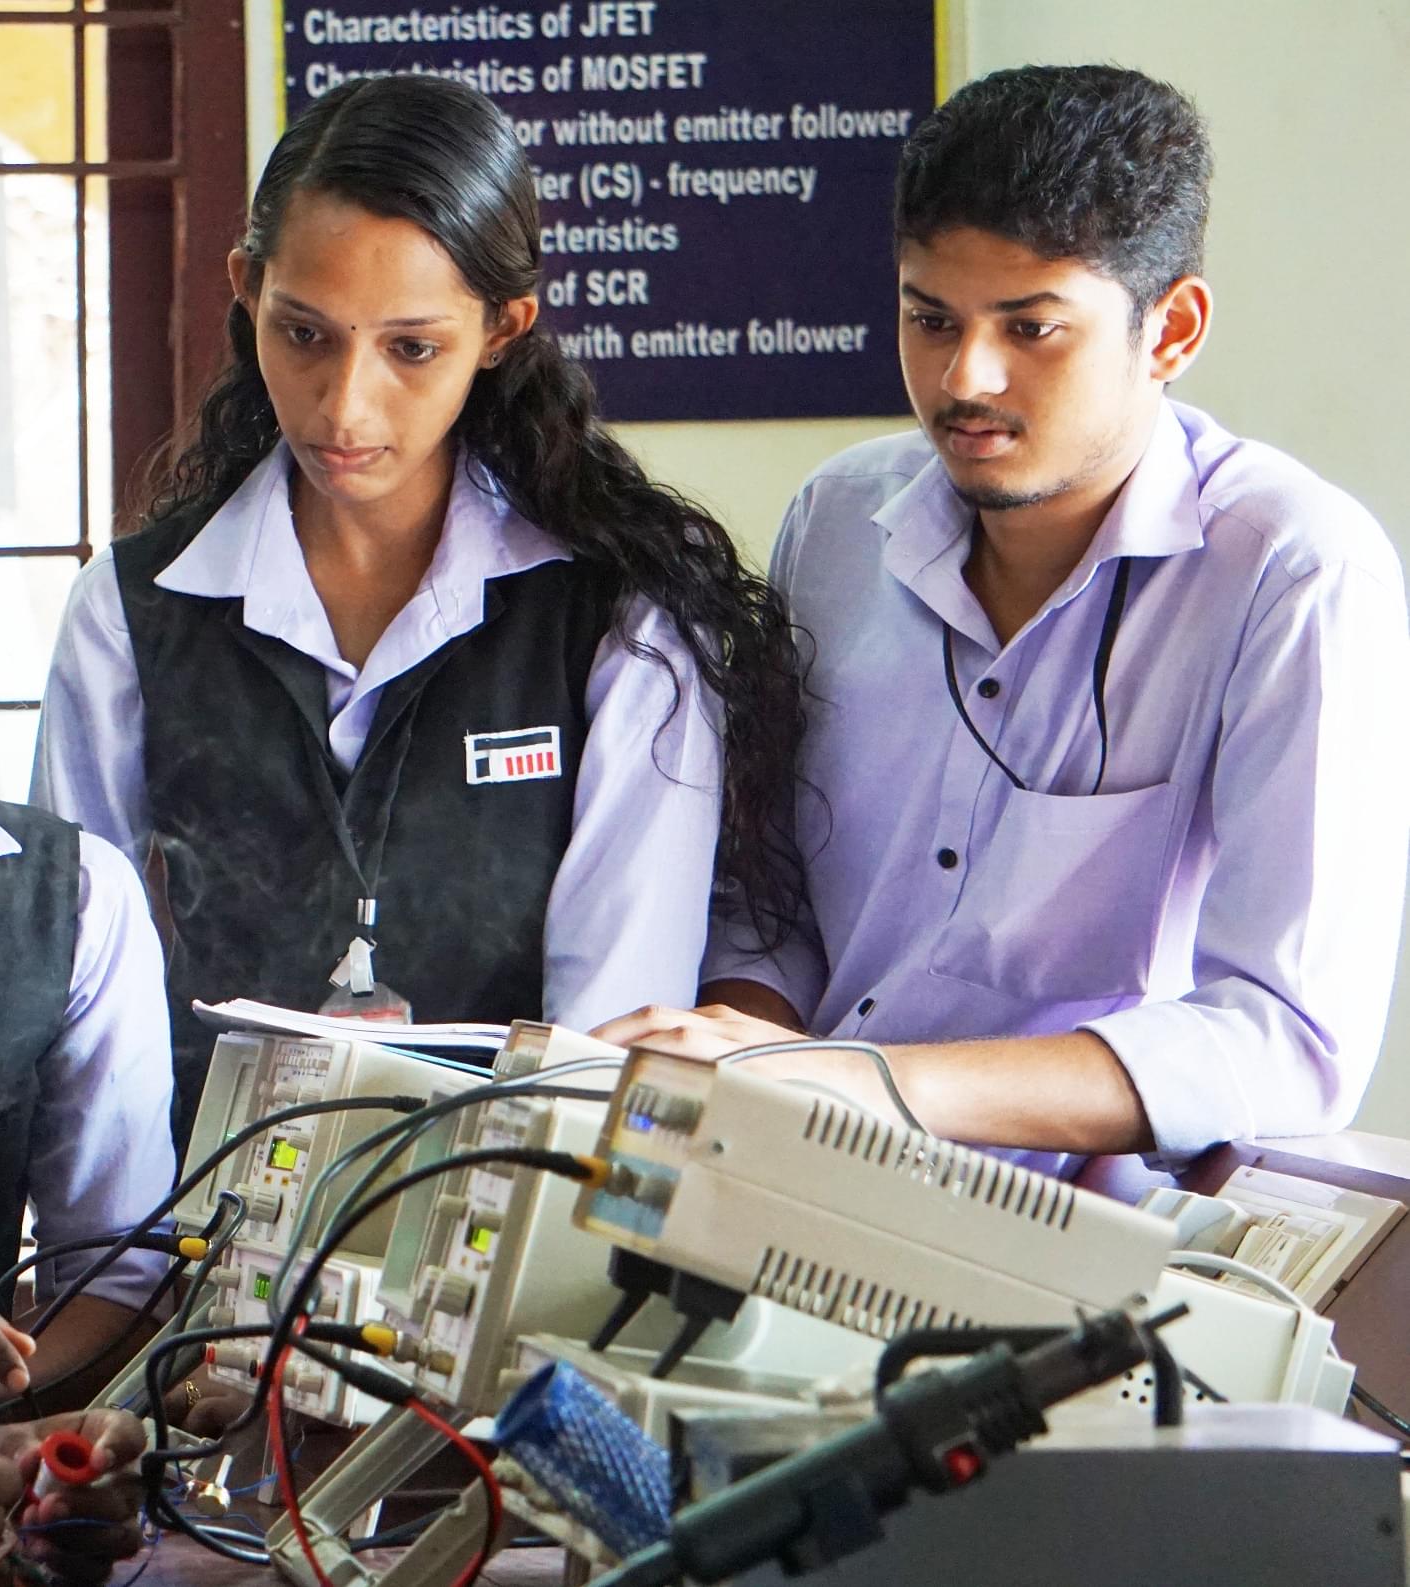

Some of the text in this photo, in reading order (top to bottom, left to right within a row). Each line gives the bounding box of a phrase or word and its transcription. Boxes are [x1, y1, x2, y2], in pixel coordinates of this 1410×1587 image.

[304, 2, 657, 44] Characteristics of JFET
[305, 53, 708, 98] Chistics of MOSFET
[552, 109, 666, 146] without
[674, 106, 784, 142] emitter
[790, 103, 911, 139] follower
[580, 162, 643, 208] (CS)
[667, 161, 817, 204] frequency
[547, 269, 649, 307] of SCR
[558, 318, 868, 360] with emitter follower
